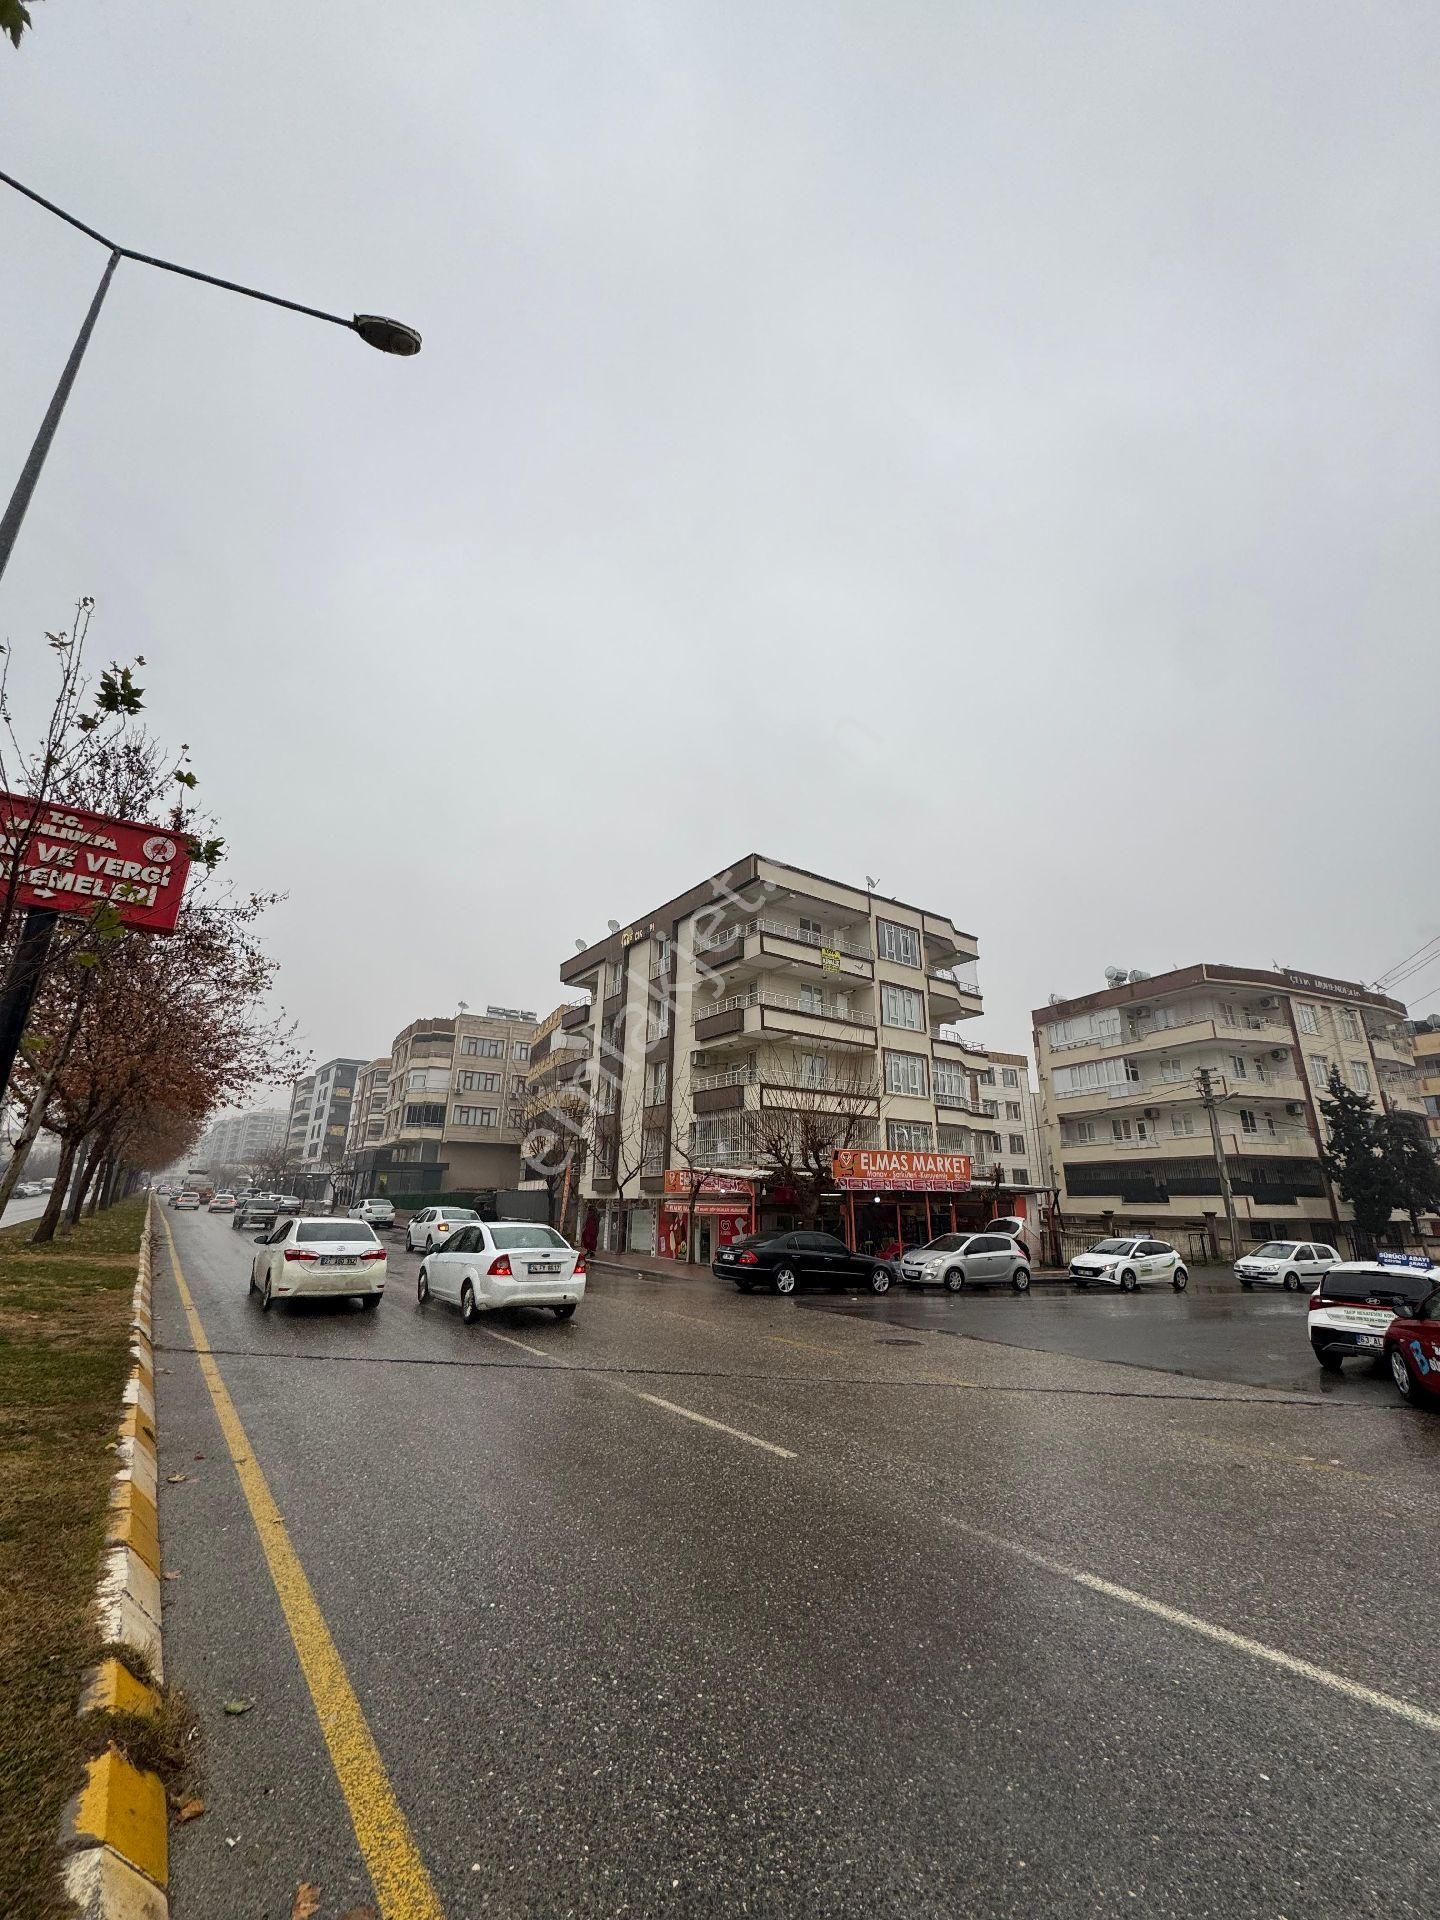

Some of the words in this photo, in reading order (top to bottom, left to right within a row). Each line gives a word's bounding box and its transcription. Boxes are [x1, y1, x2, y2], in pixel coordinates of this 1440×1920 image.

[37, 841, 79, 868] VE
[860, 1152, 908, 1171] ELMAS
[912, 1156, 966, 1174] MARKET
[1378, 1252, 1407, 1261] SÜRÜCÜ
[1408, 1255, 1430, 1263] ADAYI
